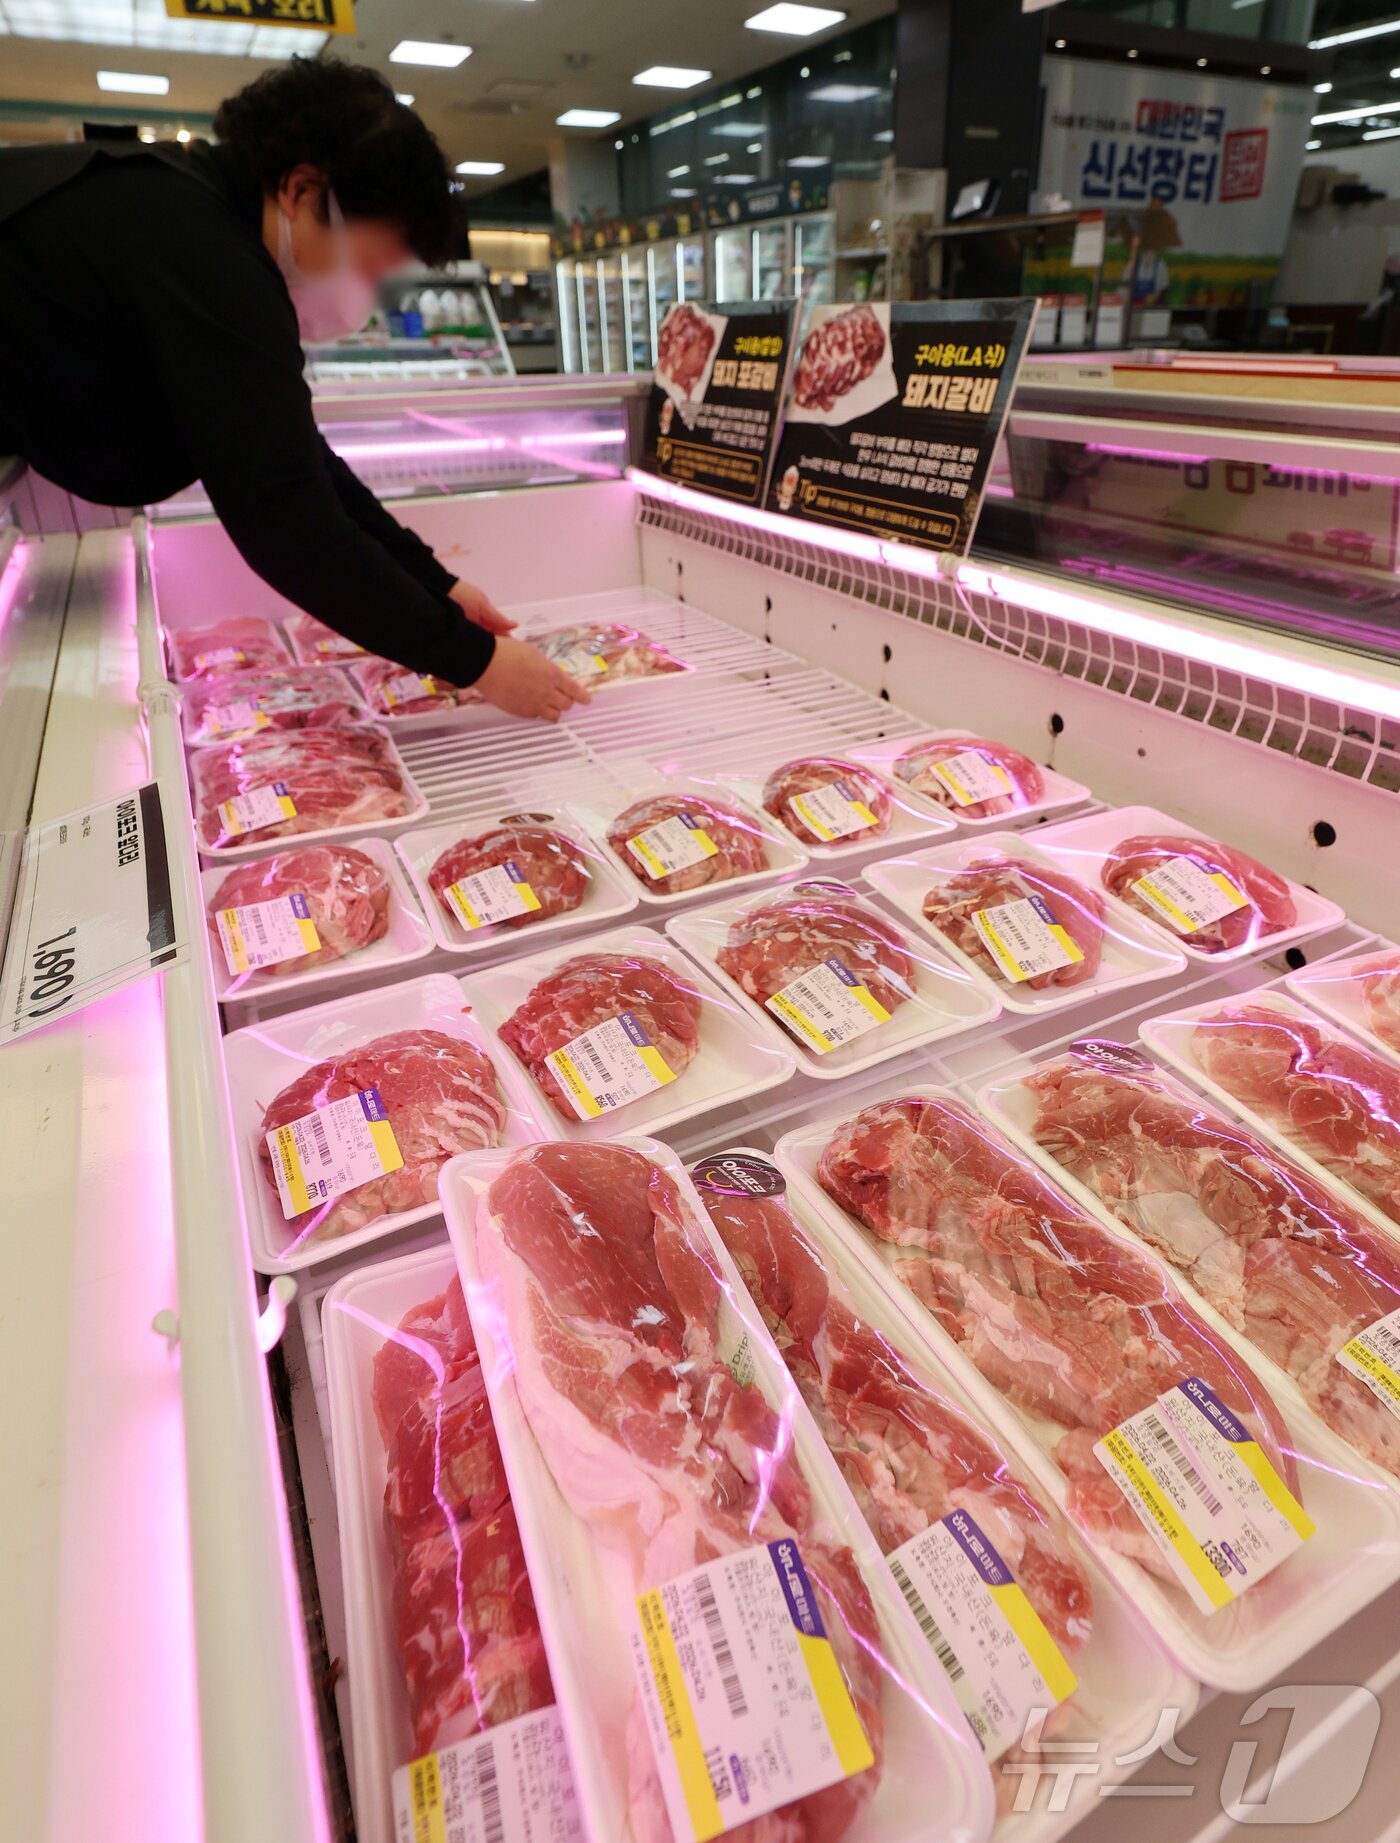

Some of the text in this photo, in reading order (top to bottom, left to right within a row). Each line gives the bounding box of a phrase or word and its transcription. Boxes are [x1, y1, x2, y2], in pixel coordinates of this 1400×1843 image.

[1136, 100, 1225, 142] 대한민국
[1080, 141, 1218, 204] 신선장터
[912, 343, 1006, 367] 구이용(LA식)
[901, 372, 999, 412] 돼지갈비
[798, 478, 818, 505] Tip
[114, 798, 139, 867] 아이포크 앞다리
[31, 926, 75, 1001] 1,690
[622, 1013, 645, 1046] 하나로마트
[821, 1029, 834, 1042] 9700
[363, 1089, 380, 1121] 하나로마트
[304, 1182, 318, 1199] 8770
[336, 1168, 346, 1182] 1690
[721, 1156, 766, 1199] 아이포크
[731, 1336, 749, 1364] Drip
[1360, 1332, 1396, 1365] 2026.04.21
[1185, 1379, 1242, 1442] 하나로마트
[1123, 1423, 1156, 1464] 2026.04.22
[1153, 1465, 1188, 1511] 2026.04.26
[950, 1512, 1004, 1584] 하나로마트
[1239, 1522, 1262, 1550] 1690
[1198, 1538, 1233, 1578] 13300
[776, 1542, 816, 1634] 하나로마트
[979, 1688, 1005, 1722] 1690
[703, 1744, 733, 1802] 11150
